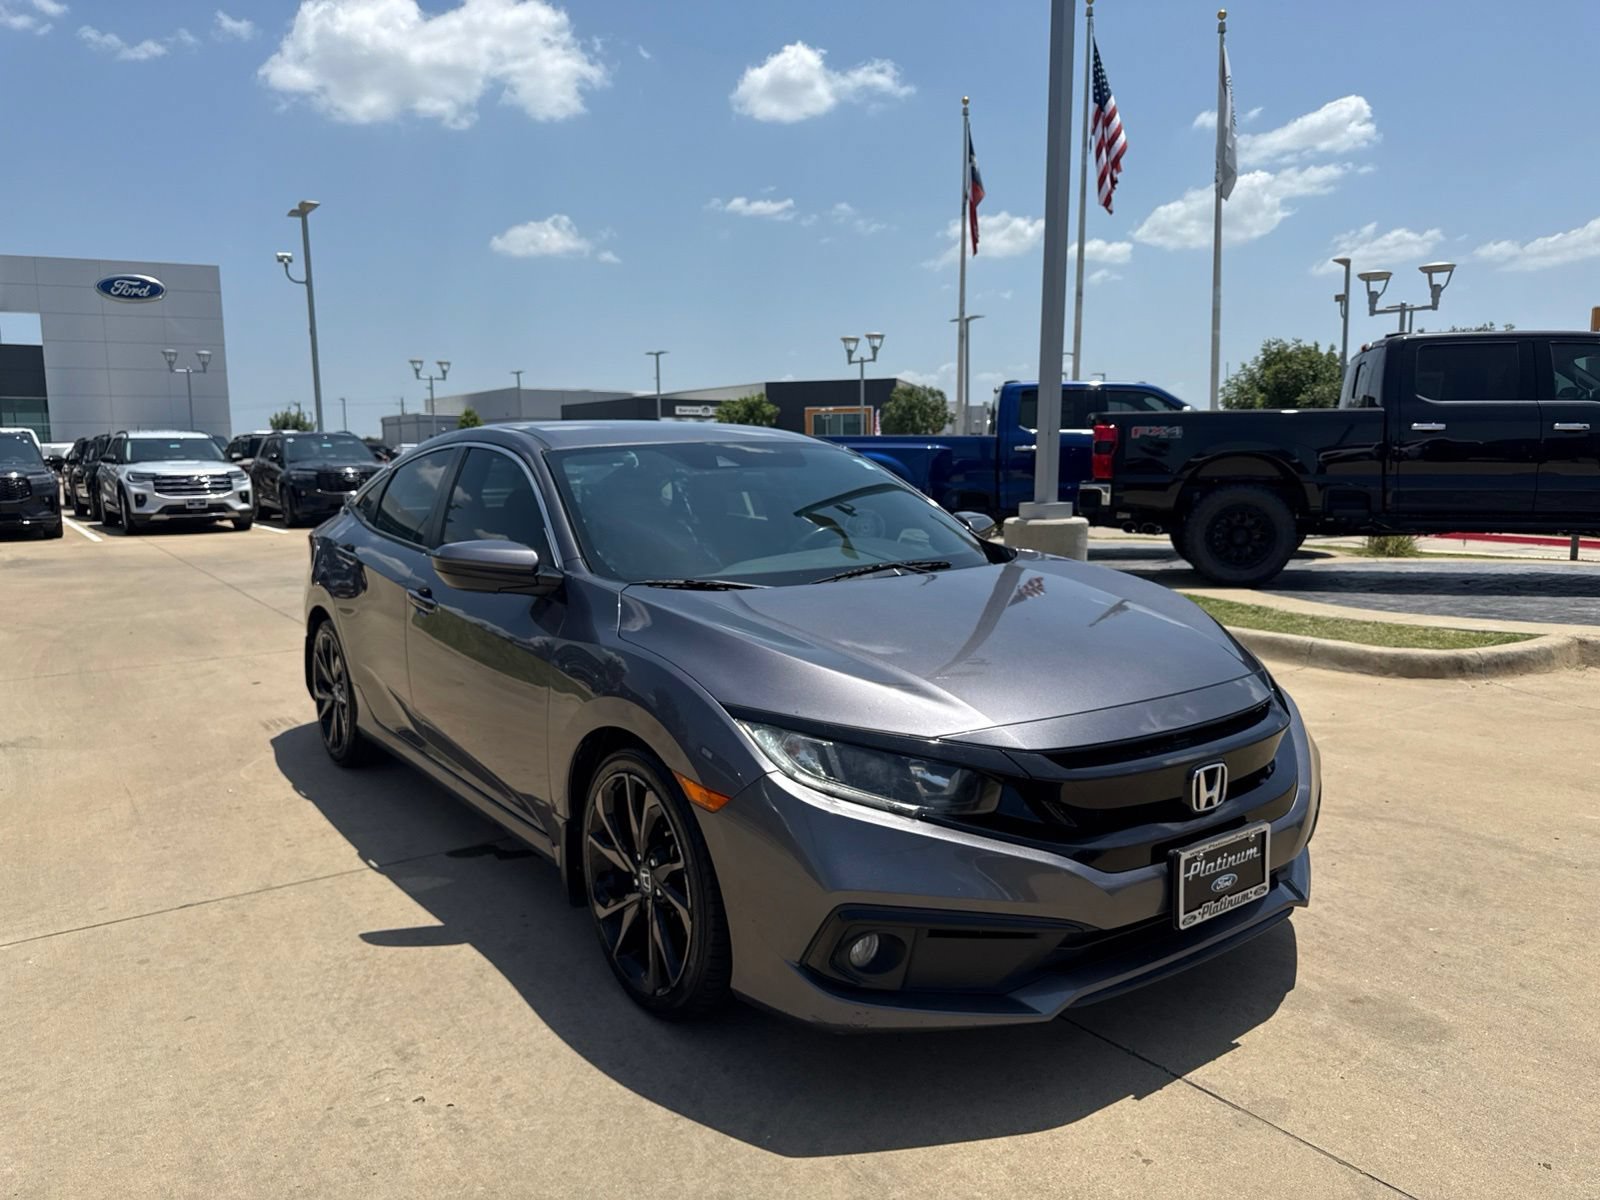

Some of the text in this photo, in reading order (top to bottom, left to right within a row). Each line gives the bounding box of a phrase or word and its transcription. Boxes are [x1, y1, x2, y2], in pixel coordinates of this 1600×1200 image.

[110, 279, 151, 297] Ford
[1131, 426, 1183, 439] FX4
[1184, 846, 1261, 881] Platinum
[1215, 876, 1233, 890] Ford
[1201, 892, 1253, 919] Platinum
